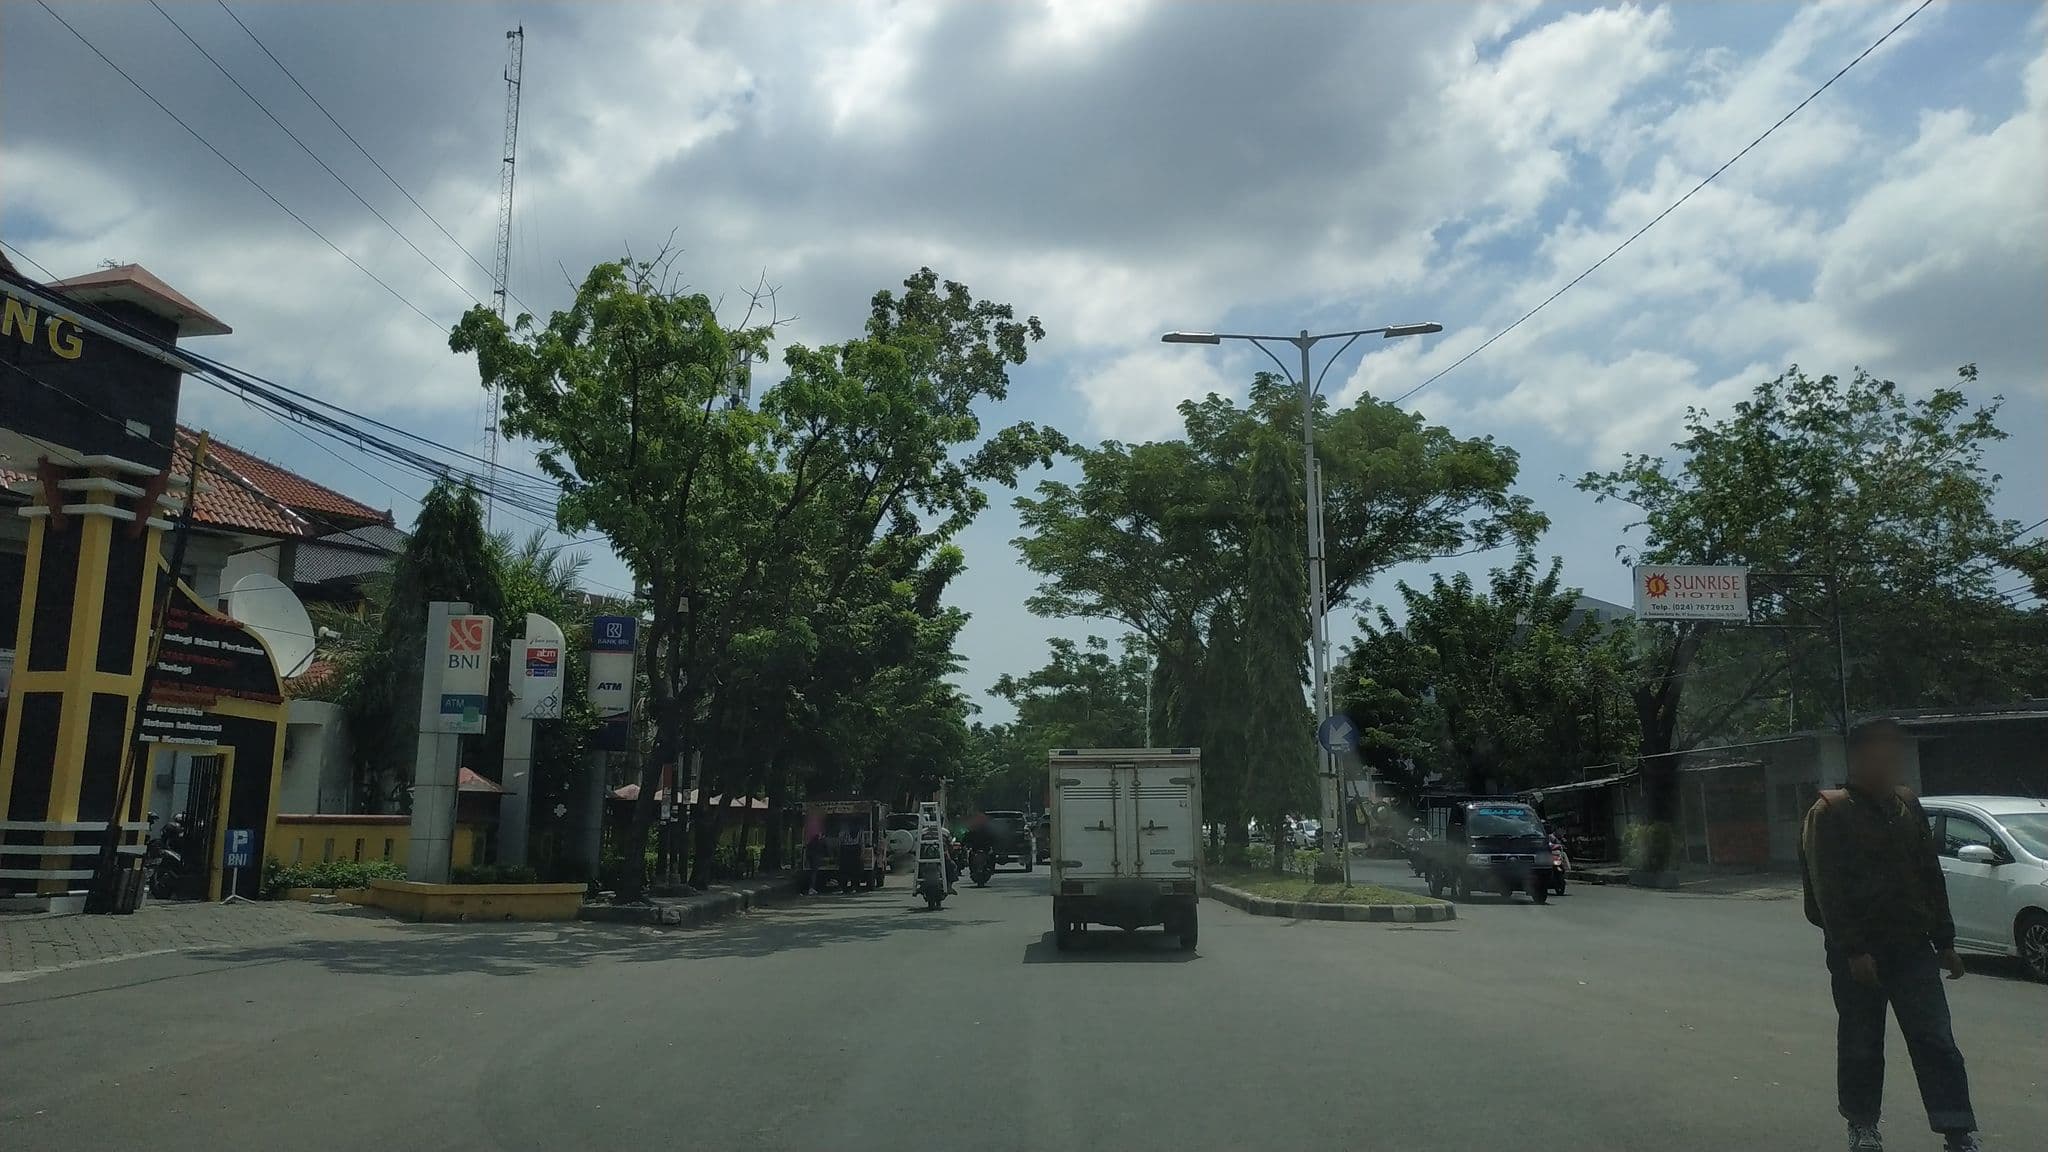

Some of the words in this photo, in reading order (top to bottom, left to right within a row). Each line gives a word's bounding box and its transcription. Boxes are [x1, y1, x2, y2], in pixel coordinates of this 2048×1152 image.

[1673, 575, 1740, 590] SUNRISE
[1672, 603, 1693, 611] (024)
[536, 649, 556, 657] atm
[448, 654, 480, 669] BNI
[597, 682, 623, 691] ATM
[445, 698, 465, 708] ATM
[232, 830, 248, 853] P
[228, 853, 248, 866] BNI
